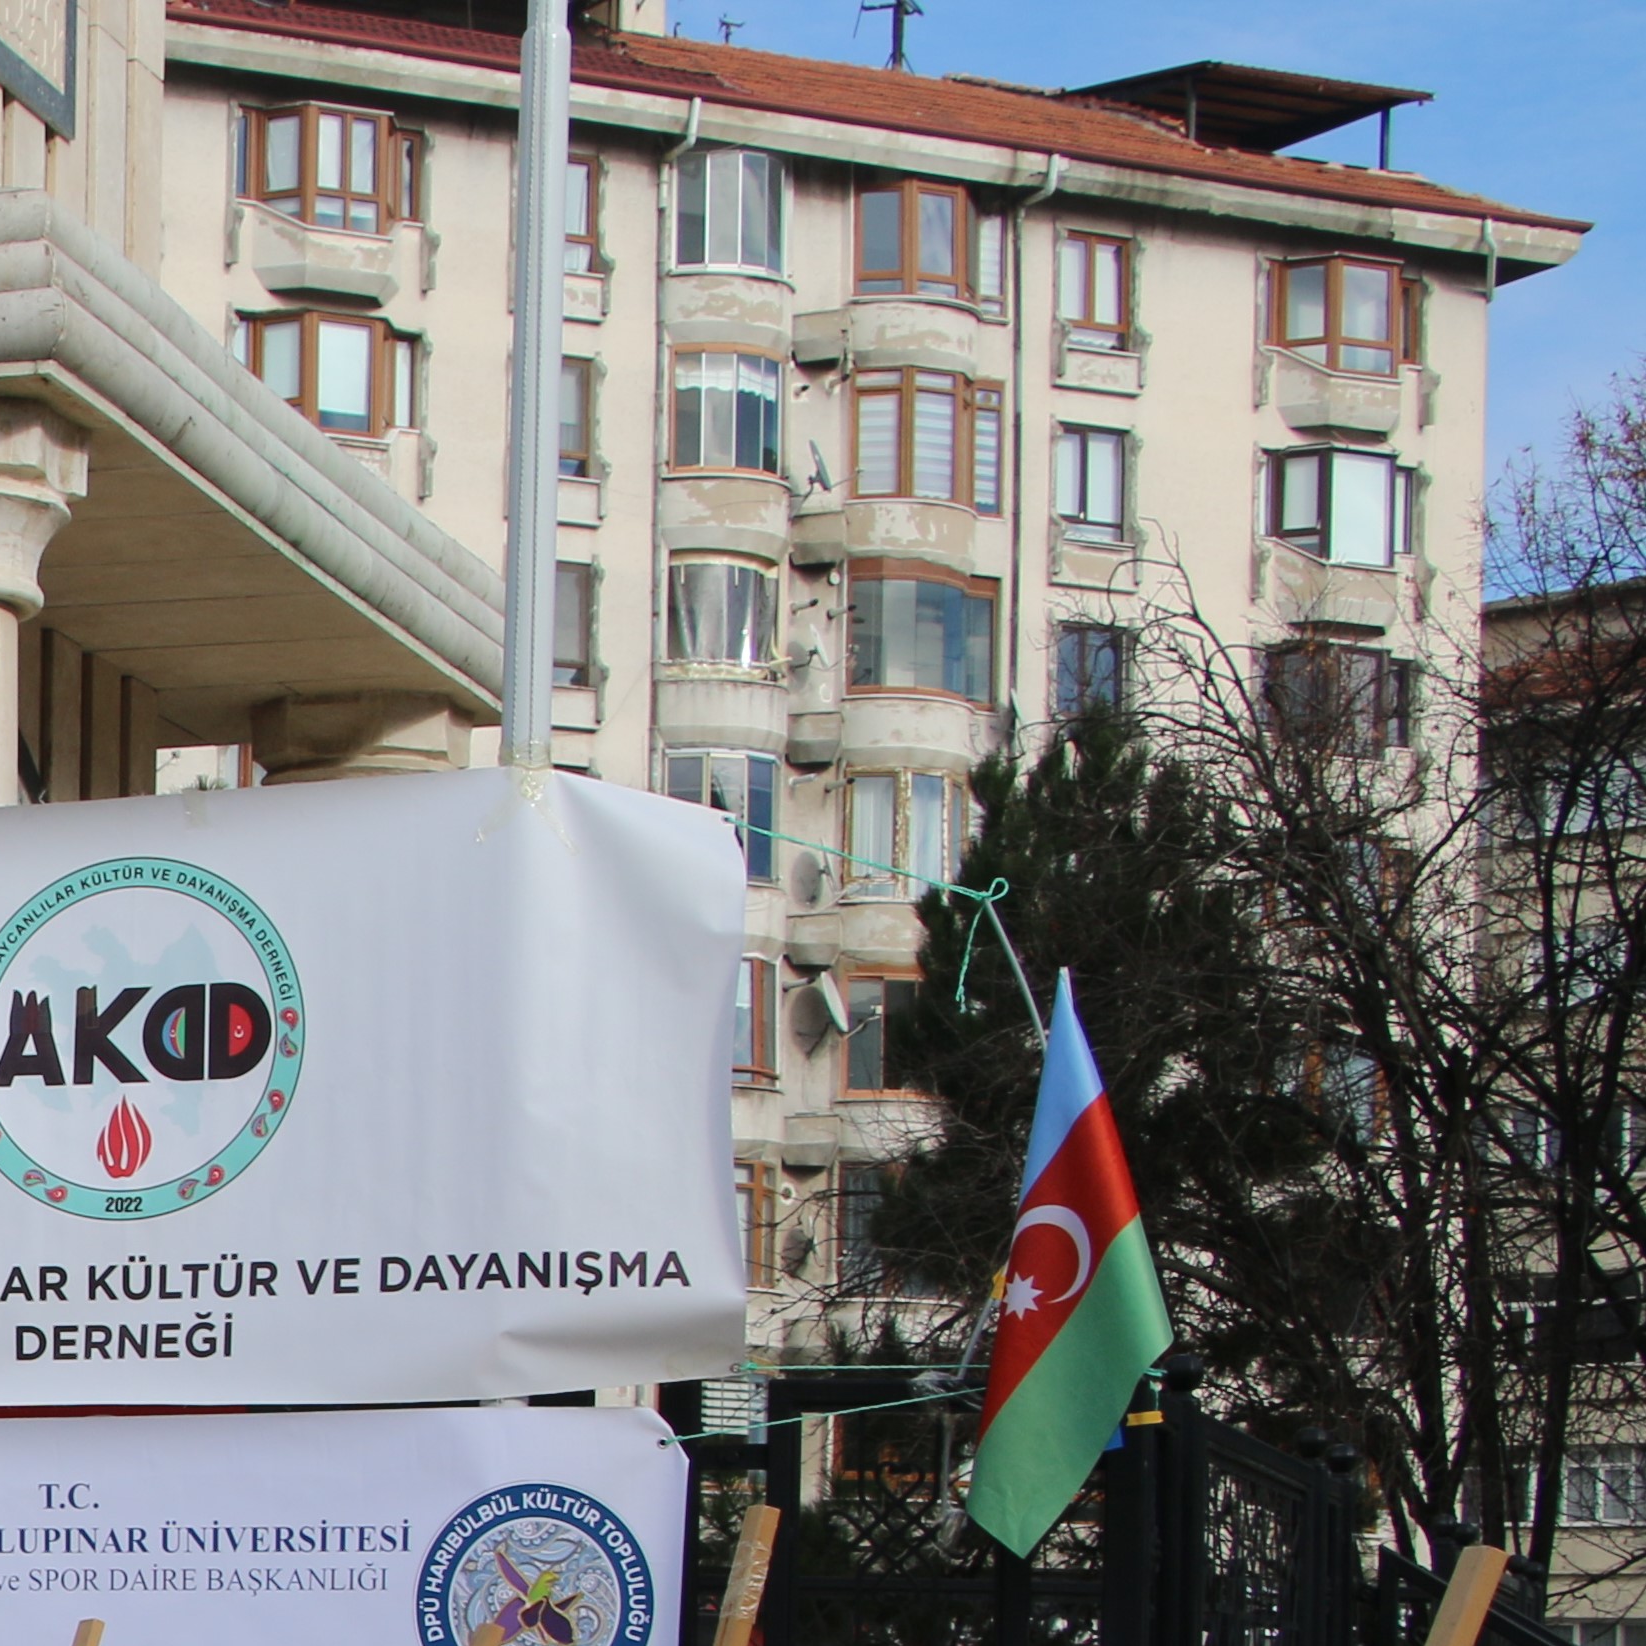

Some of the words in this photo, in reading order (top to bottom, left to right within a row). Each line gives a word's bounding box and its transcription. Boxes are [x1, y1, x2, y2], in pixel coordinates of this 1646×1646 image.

[80, 865, 145, 891] KÜLTÜR
[151, 867, 172, 882] VE
[176, 872, 257, 930] DAYANIŞMA
[255, 929, 296, 1002] DERNEĞİ
[104, 1196, 144, 1214] 2022
[87, 1253, 278, 1302] KÜLTÜR
[296, 1257, 361, 1295] VE
[379, 1250, 692, 1297] DAYANIŞMA
[15, 1311, 234, 1362] DERNEĞİ
[38, 1483, 101, 1511] T.C.
[522, 1487, 602, 1529] KÜLTÜR
[159, 1518, 413, 1554] ÜNİVERSİTESİ
[424, 1493, 521, 1593] HARIBÜLBÜL
[28, 1568, 101, 1592] SPOR
[109, 1563, 199, 1592] DAİRE
[206, 1561, 388, 1597] BAŞKANLIĞI
[598, 1519, 650, 1642] TOPLULUĞU
[418, 1594, 445, 1643] DPÜ
